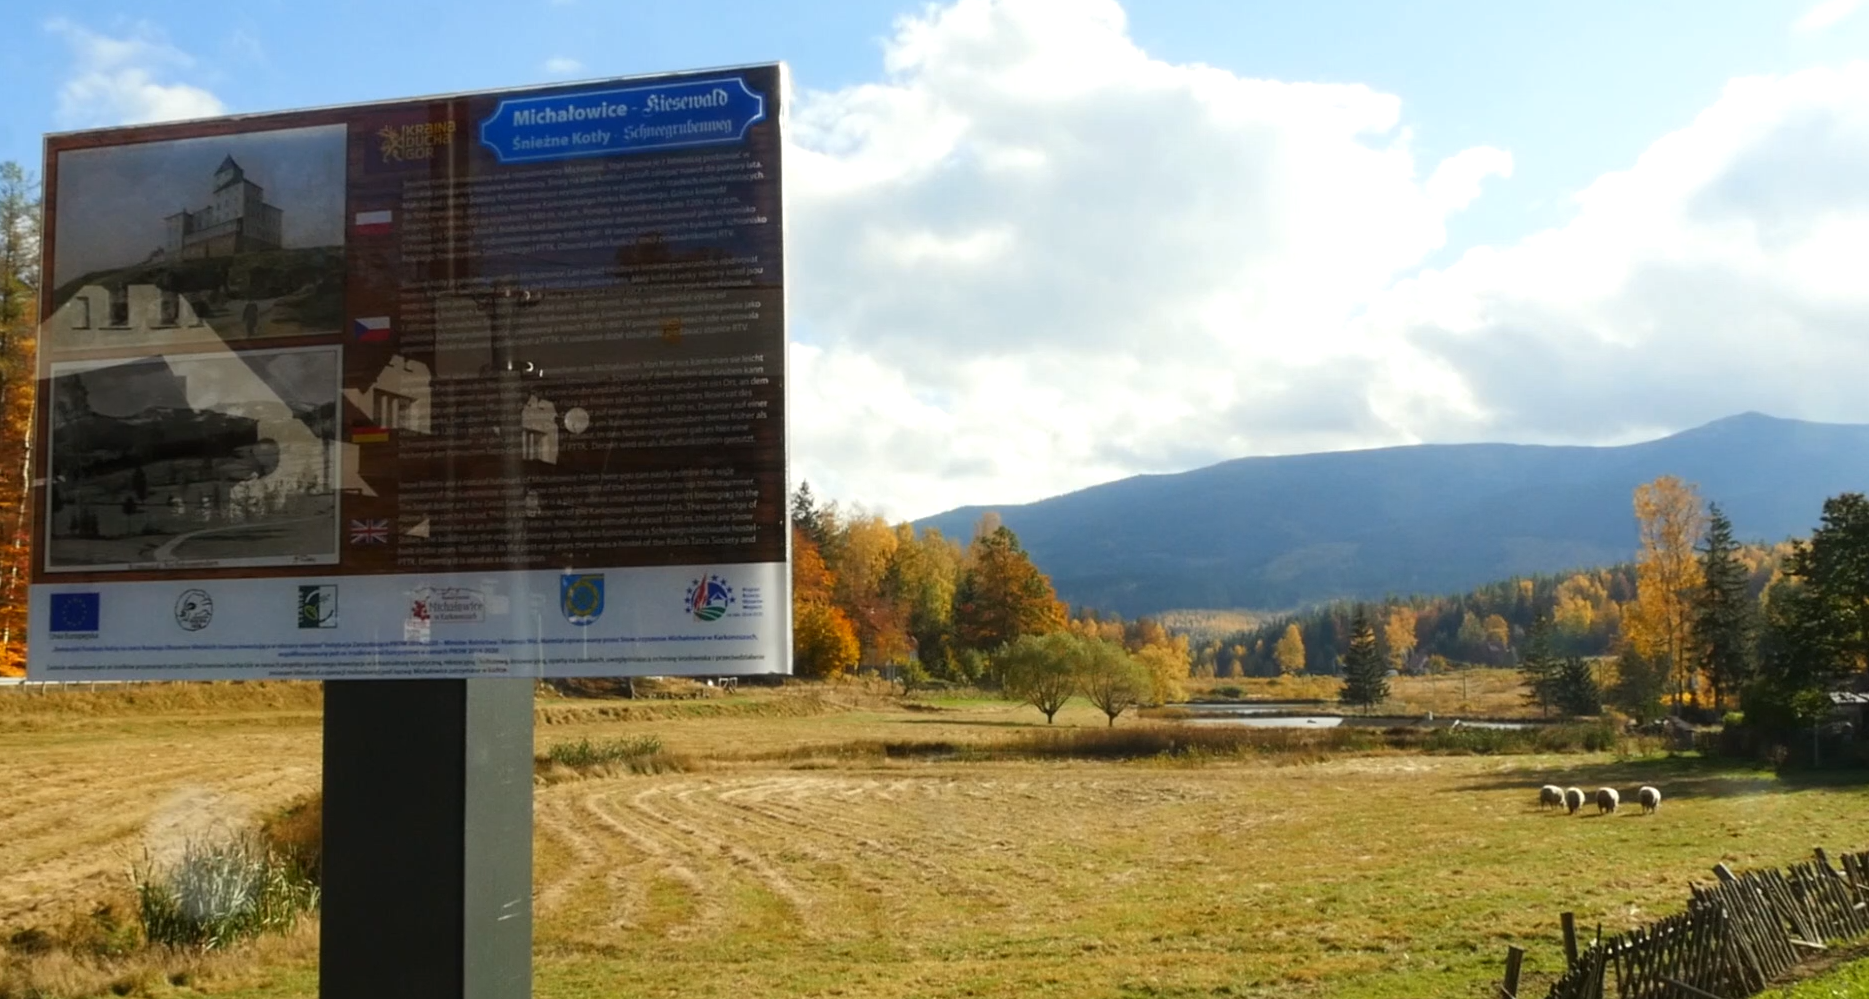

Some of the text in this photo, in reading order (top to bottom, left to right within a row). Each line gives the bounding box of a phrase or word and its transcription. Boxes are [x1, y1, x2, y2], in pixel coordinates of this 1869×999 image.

[512, 102, 627, 126] Michałowice
[512, 131, 568, 150] Śnieżne
[572, 129, 610, 147] Kotły
